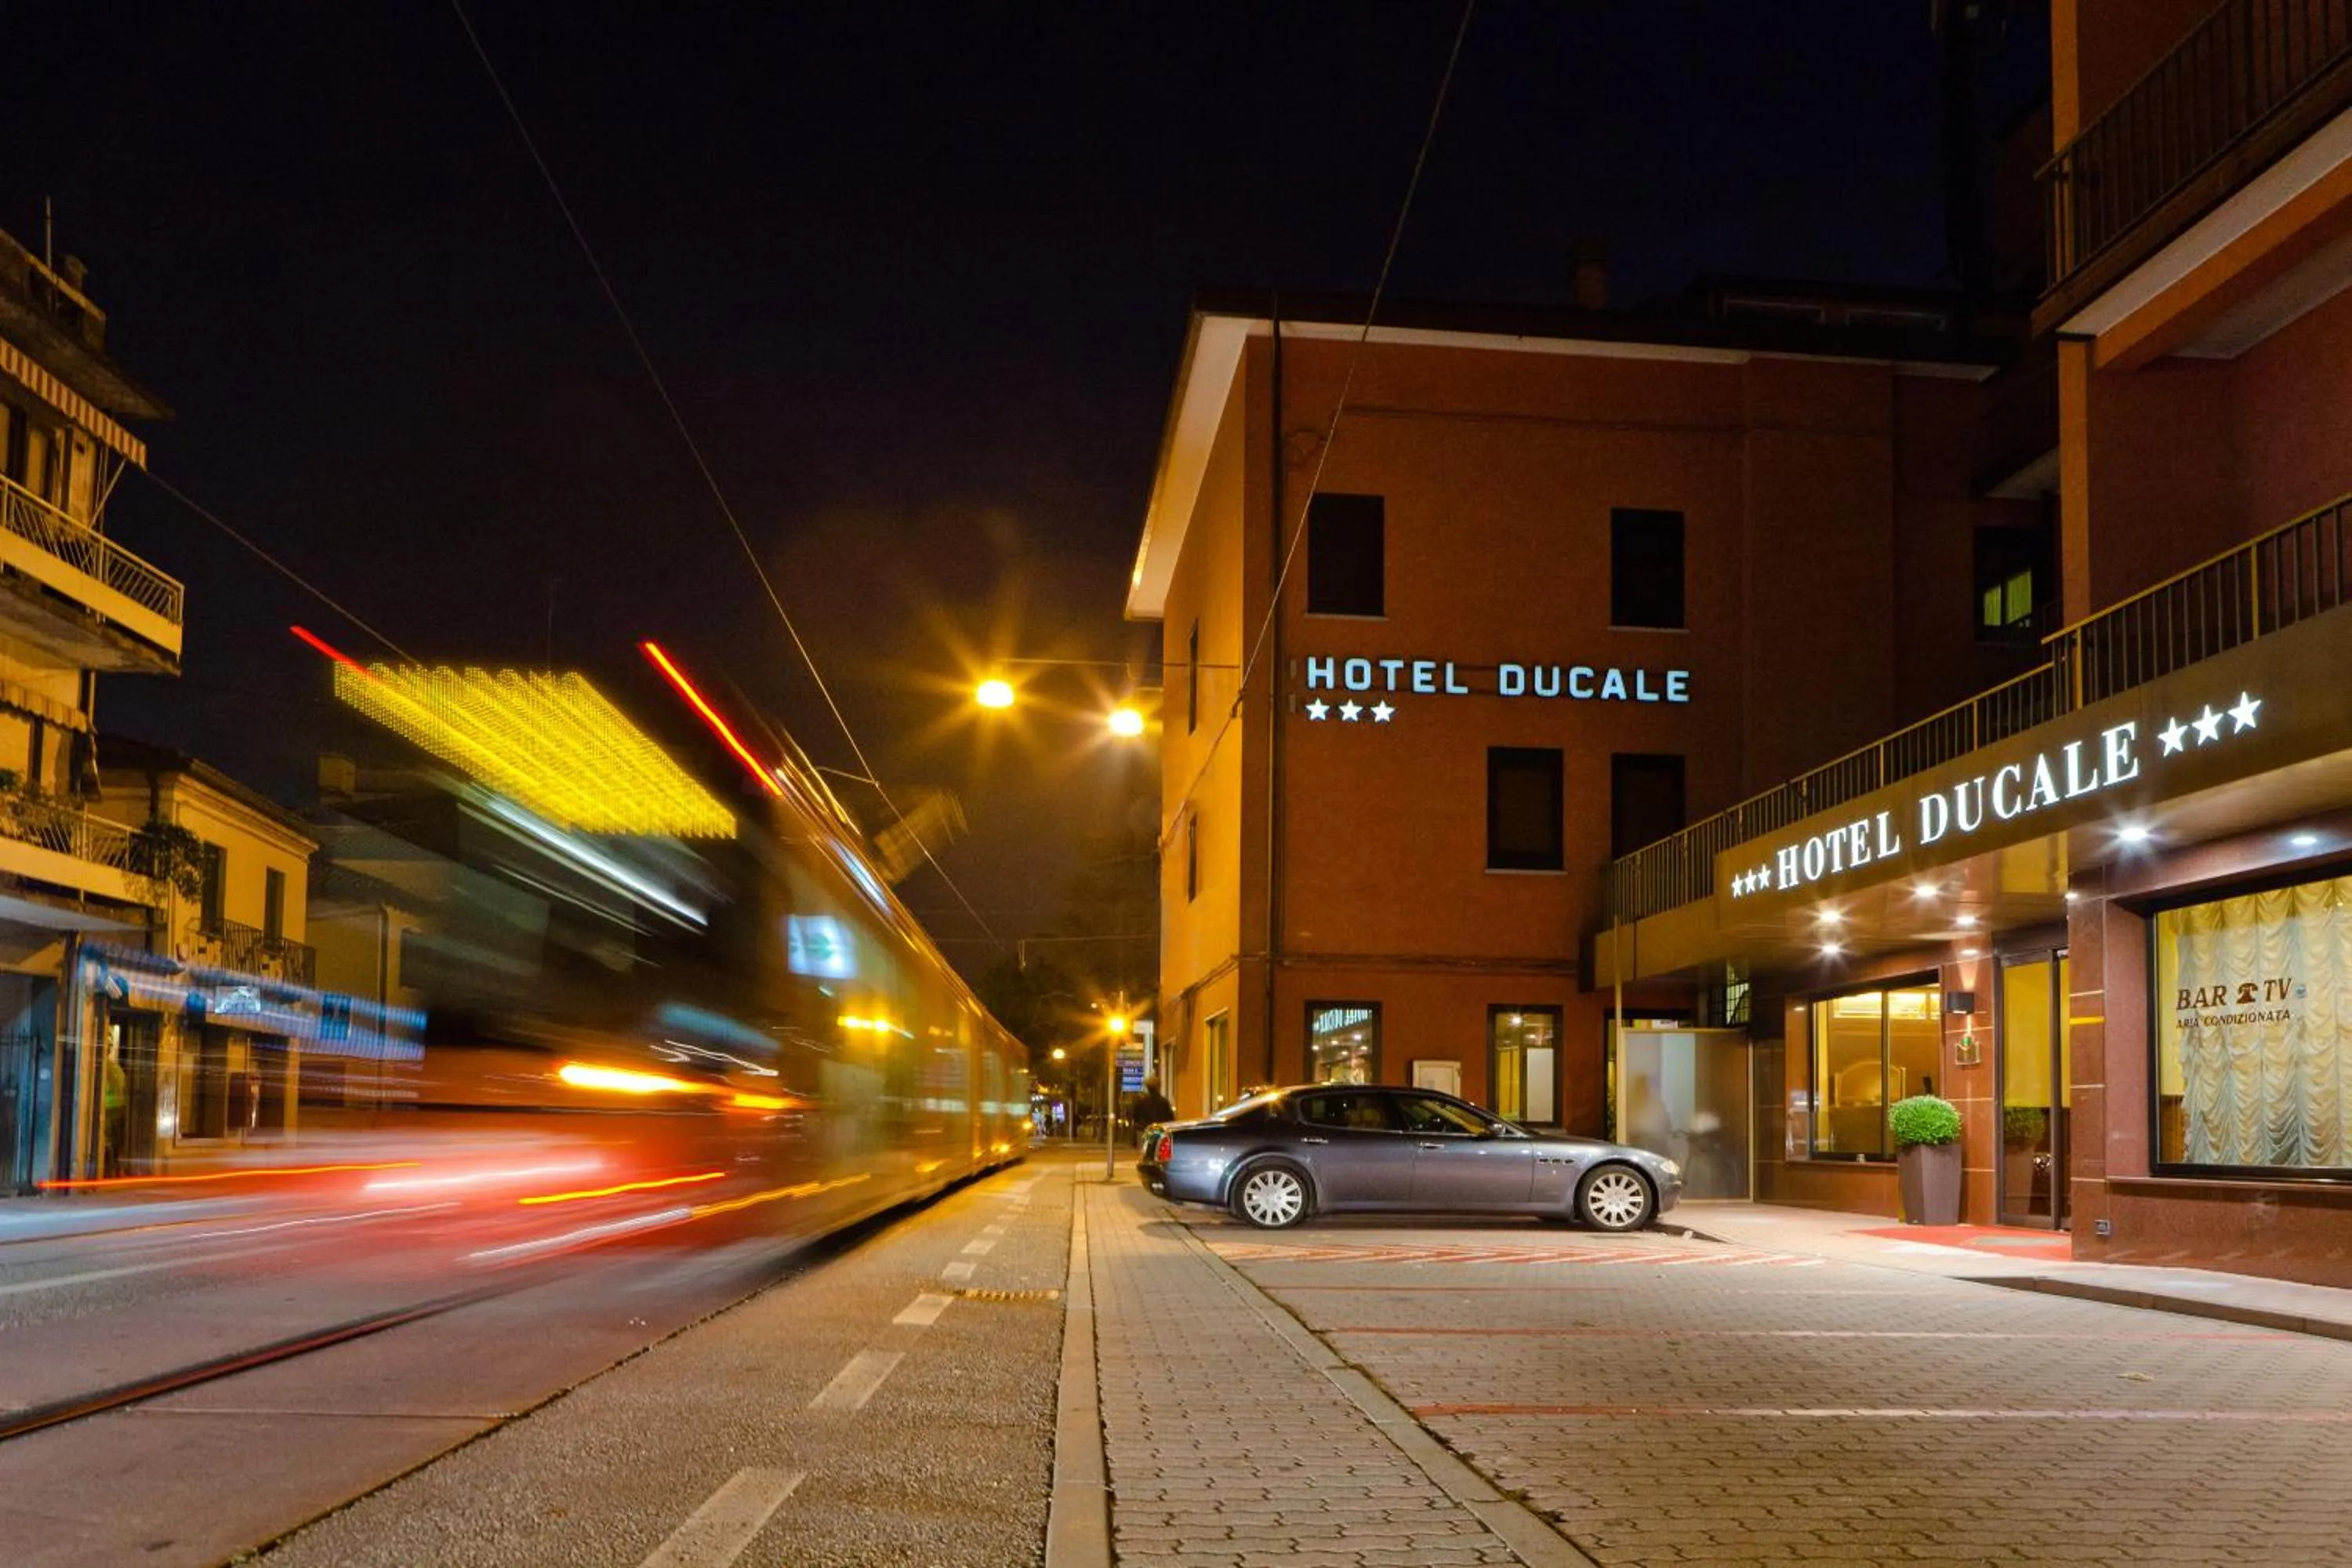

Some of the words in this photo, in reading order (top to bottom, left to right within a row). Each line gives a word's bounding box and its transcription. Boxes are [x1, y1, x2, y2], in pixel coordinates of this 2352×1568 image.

[1306, 655, 1468, 694] HOTEL
[1498, 663, 1690, 702] DUCALE
[1777, 811, 1900, 891] HOTEL
[1918, 720, 2140, 845] DUCALE
[2176, 985, 2227, 1010] BAR
[2263, 978, 2292, 1002] TV
[2176, 1016, 2199, 1029] ARIA
[2204, 1009, 2290, 1027] CONDIZIONATA
